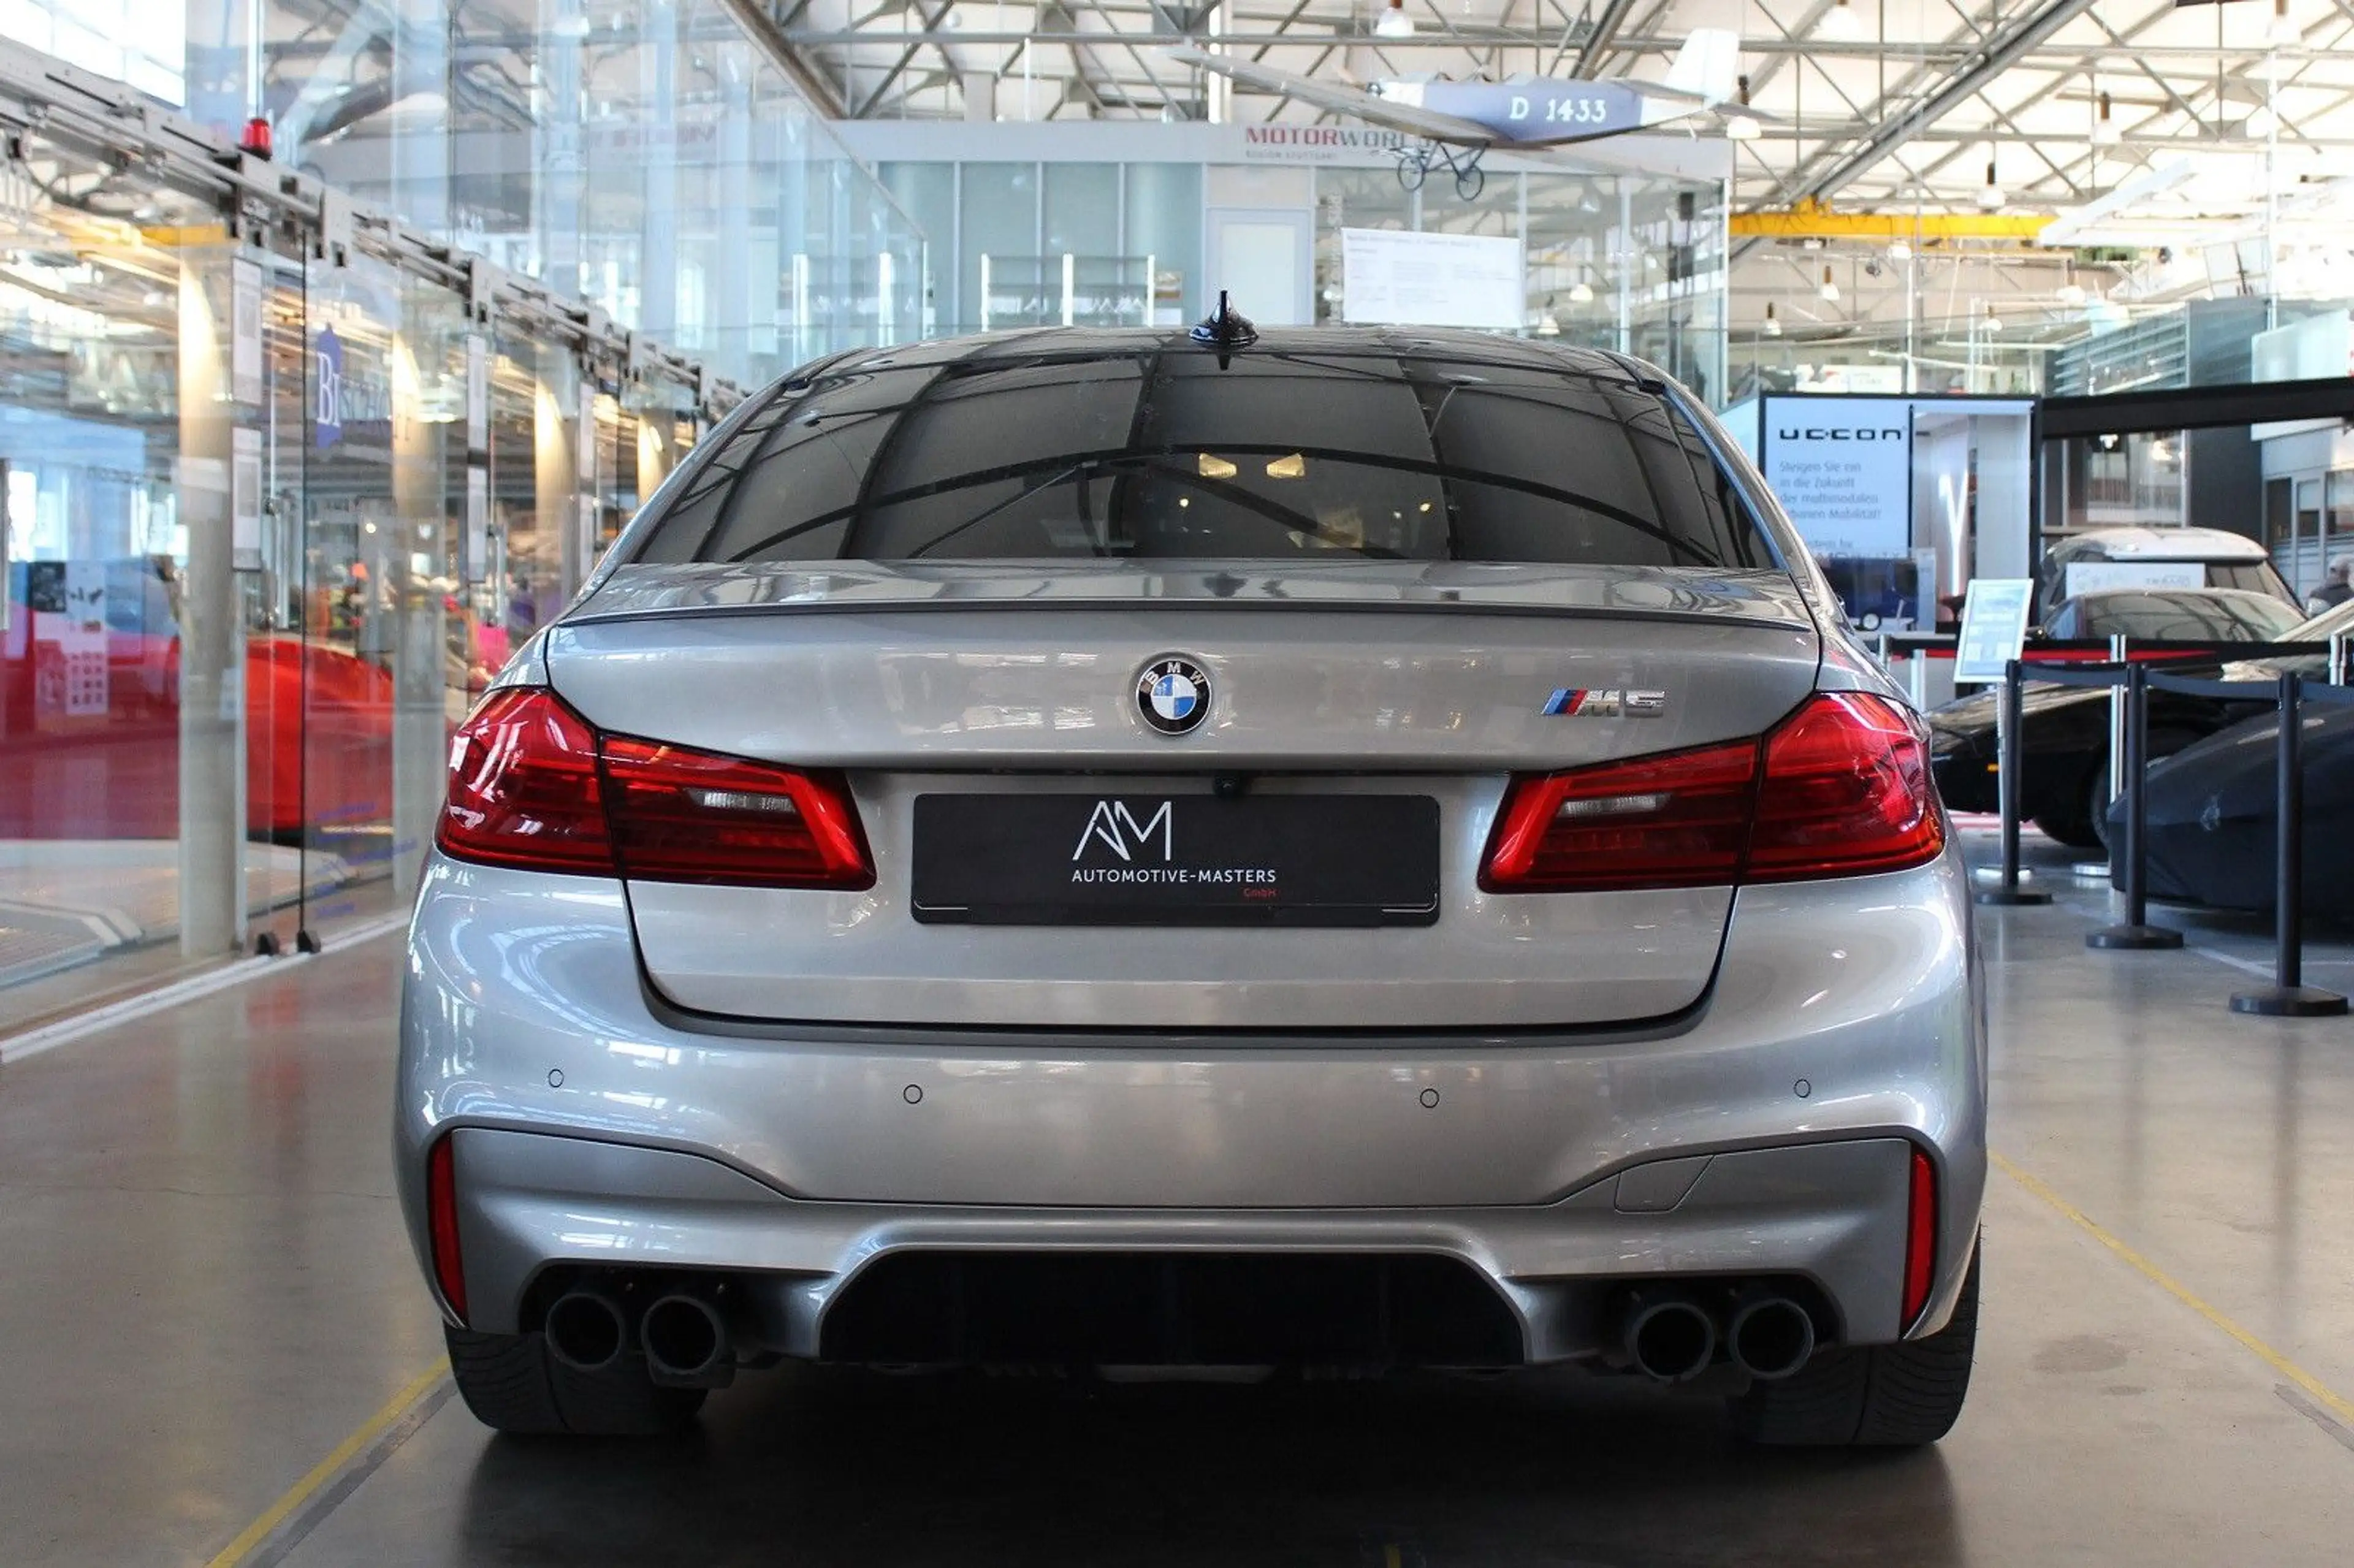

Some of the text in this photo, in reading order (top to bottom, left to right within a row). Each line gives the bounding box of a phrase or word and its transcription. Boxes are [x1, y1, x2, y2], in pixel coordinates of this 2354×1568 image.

[1509, 96, 1607, 124] D 1433
[1144, 661, 1206, 685] BMW
[1072, 800, 1171, 861] AM
[1072, 869, 1278, 883] AUTOMOTIVE-MASTERS
[1243, 888, 1278, 898] GmbH
